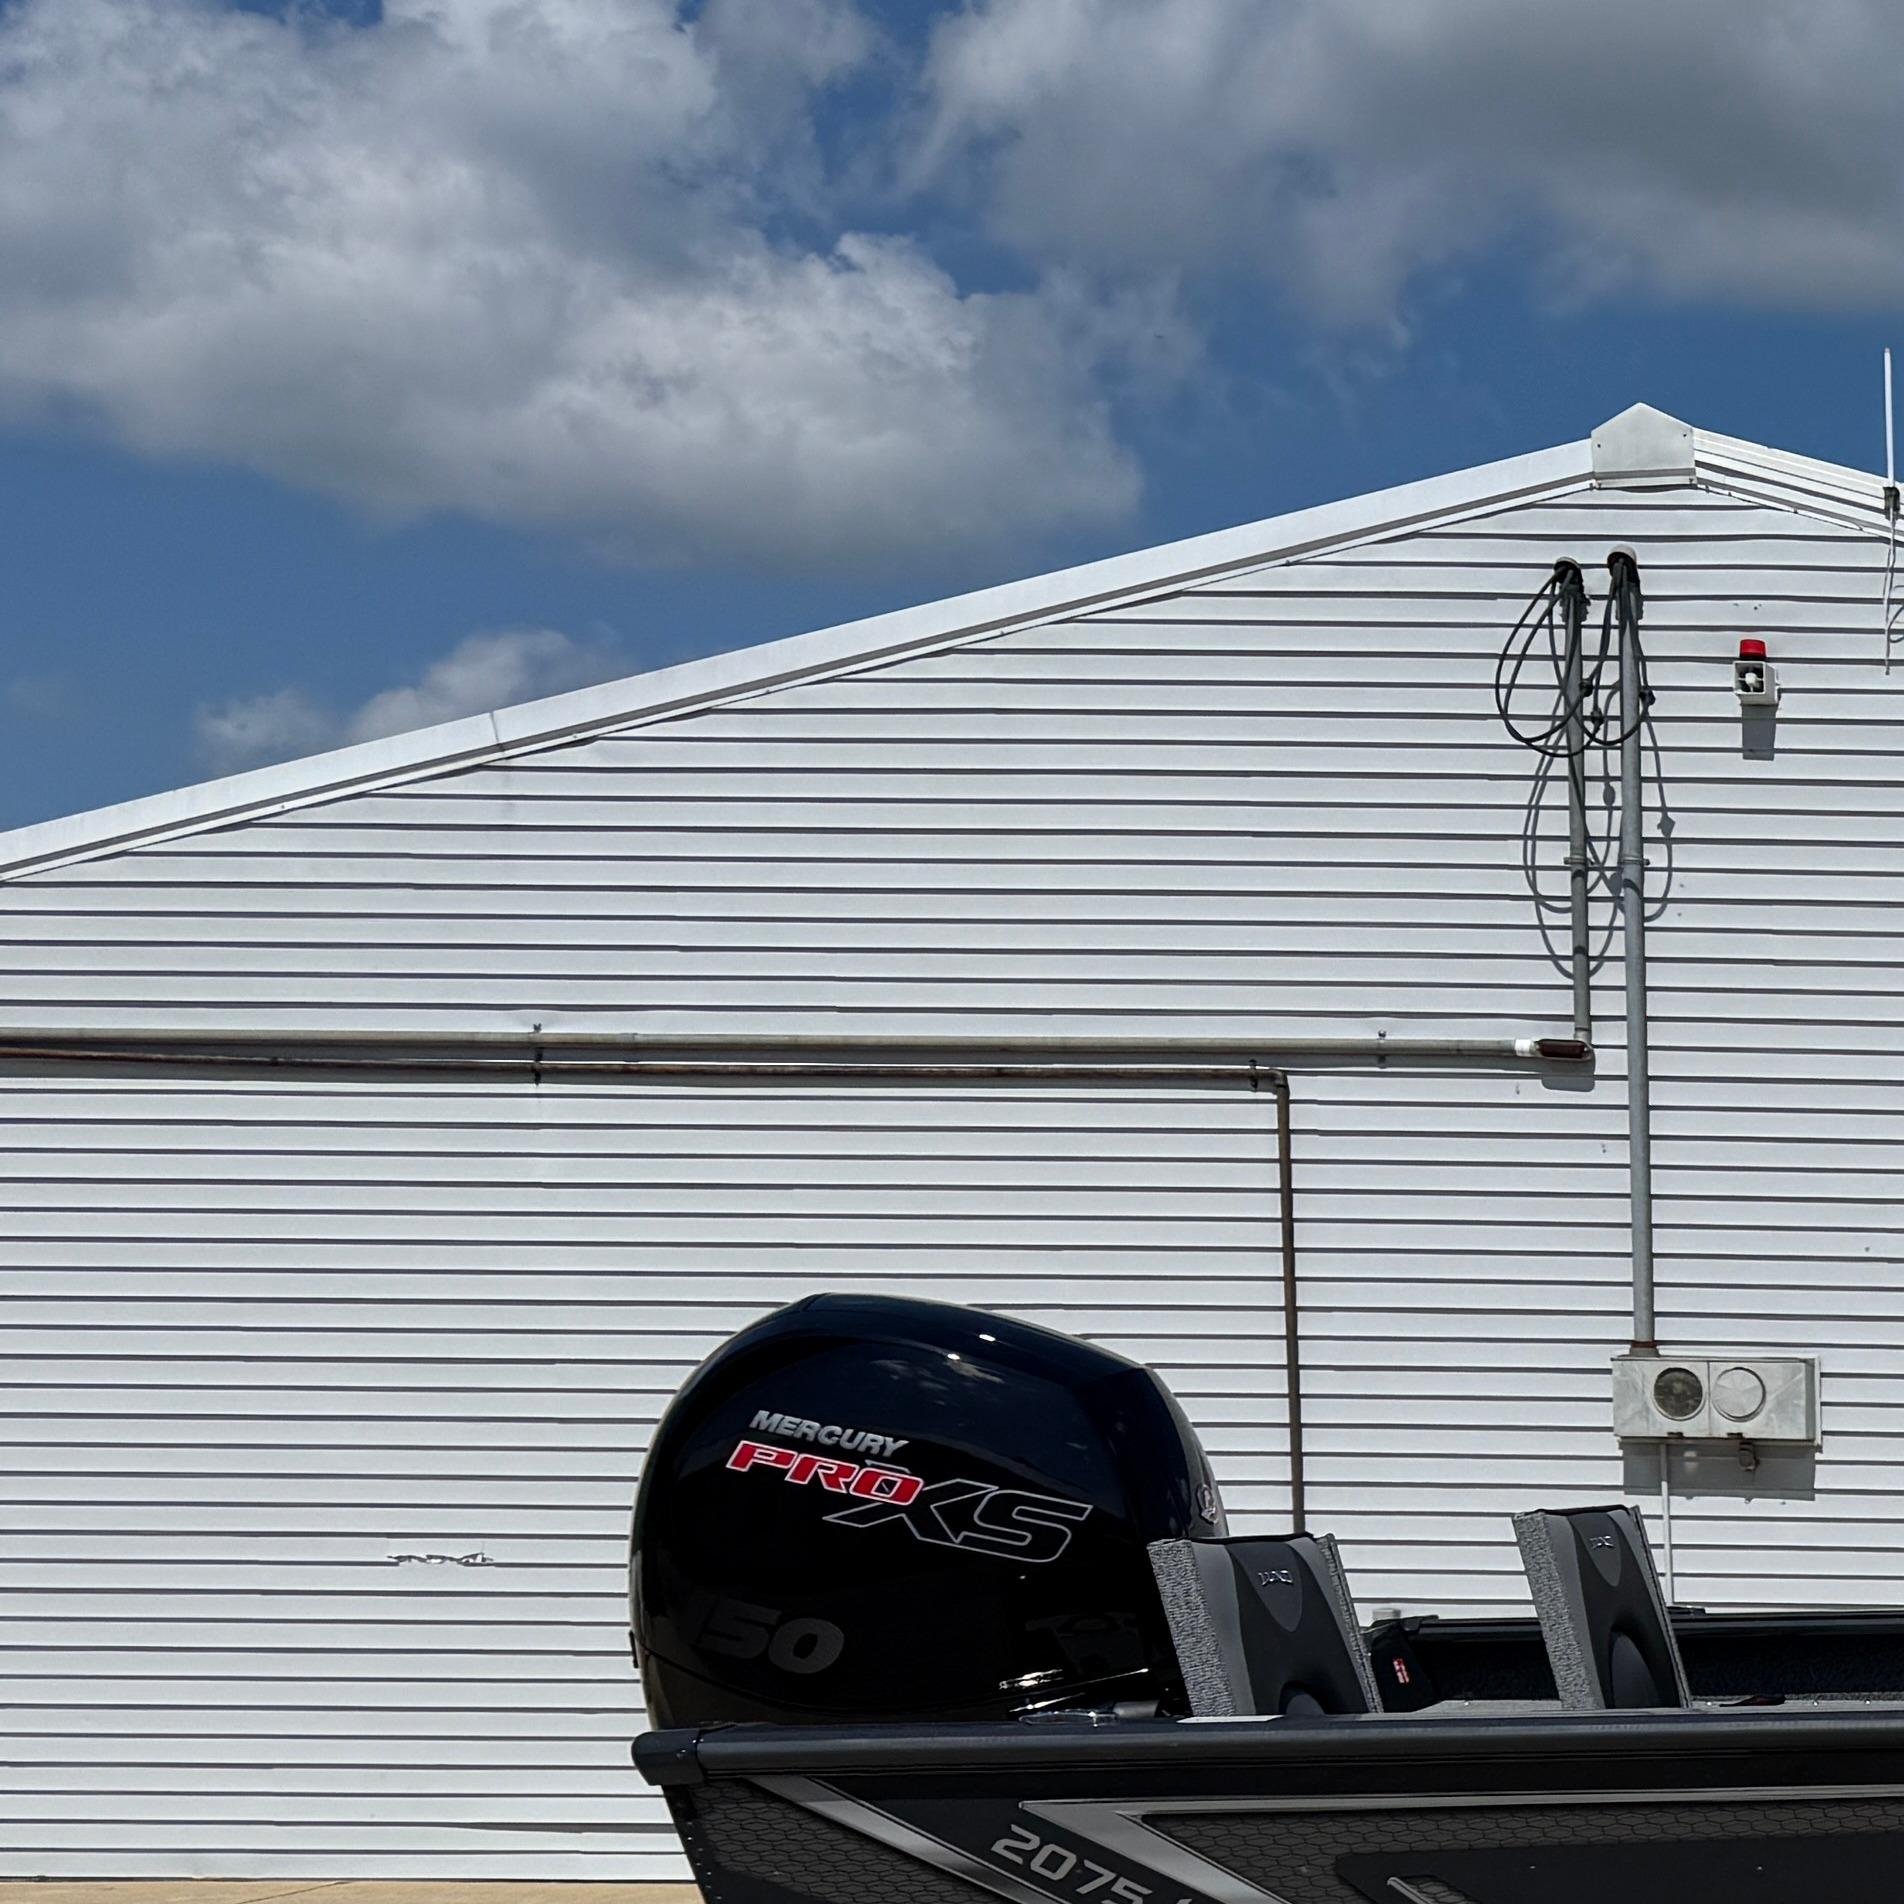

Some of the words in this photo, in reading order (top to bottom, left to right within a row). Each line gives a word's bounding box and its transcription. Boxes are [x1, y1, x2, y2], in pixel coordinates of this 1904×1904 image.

[749, 1410, 910, 1457] MERCURY
[726, 1440, 924, 1506] PRO
[822, 1459, 1094, 1563] XS
